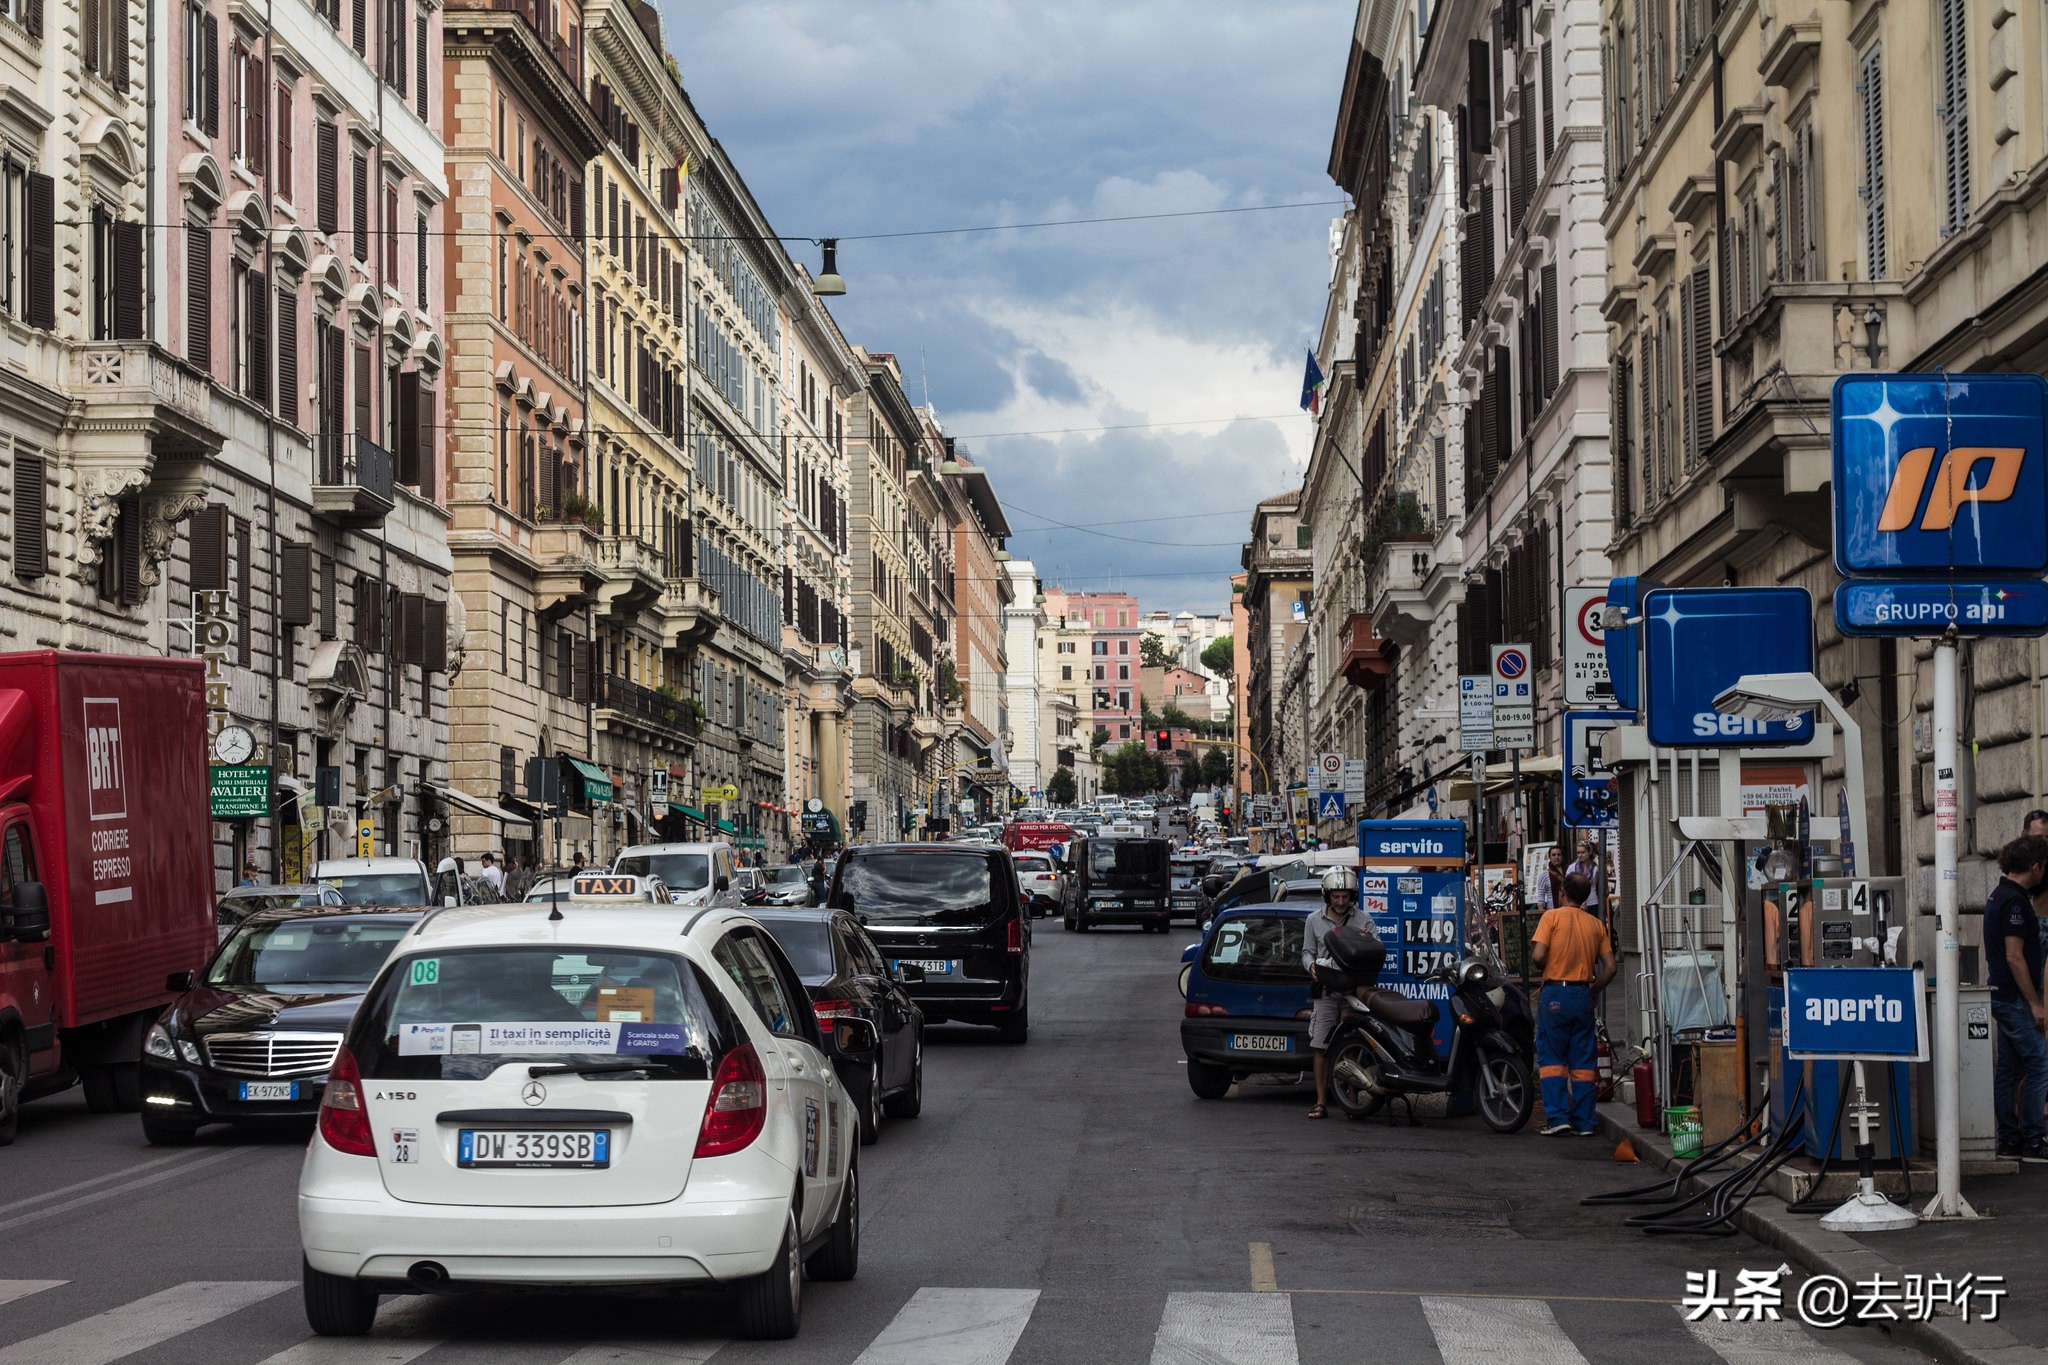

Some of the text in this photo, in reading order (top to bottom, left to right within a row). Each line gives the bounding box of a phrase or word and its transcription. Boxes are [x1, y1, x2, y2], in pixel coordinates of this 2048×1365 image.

[1877, 446, 2026, 532] IP
[1294, 602, 1301, 612] P
[1875, 603, 2005, 623] GRUPPO api
[1590, 611, 1601, 632] 3
[1575, 670, 1609, 678] ai 35
[1465, 681, 1472, 689] P
[1498, 685, 1506, 695] P
[1527, 733, 1532, 742] R
[88, 727, 120, 790] BRT
[1327, 760, 1337, 768] 30
[218, 770, 250, 778] HOTEL
[654, 771, 665, 789] T
[210, 786, 267, 797] AVALIERI
[91, 828, 130, 853] CORRIERE
[1380, 838, 1443, 855] servito
[93, 856, 131, 881] ESPRESSO
[576, 879, 632, 894] TAXI
[1365, 880, 1387, 888] CM
[1787, 892, 1798, 918] 2
[1854, 884, 1867, 911] 4
[1376, 924, 1398, 934] esel
[414, 961, 437, 983] 08
[1374, 981, 1450, 1000] TAMAXIMA
[1805, 994, 1903, 1026] aperto
[490, 1028, 611, 1041] Il taxi in semplicità
[658, 1032, 680, 1040] subito
[1235, 1036, 1286, 1050] CG 604CH
[395, 1144, 409, 1162] 28
[476, 1134, 505, 1159] DW
[515, 1134, 591, 1159] 339SB
